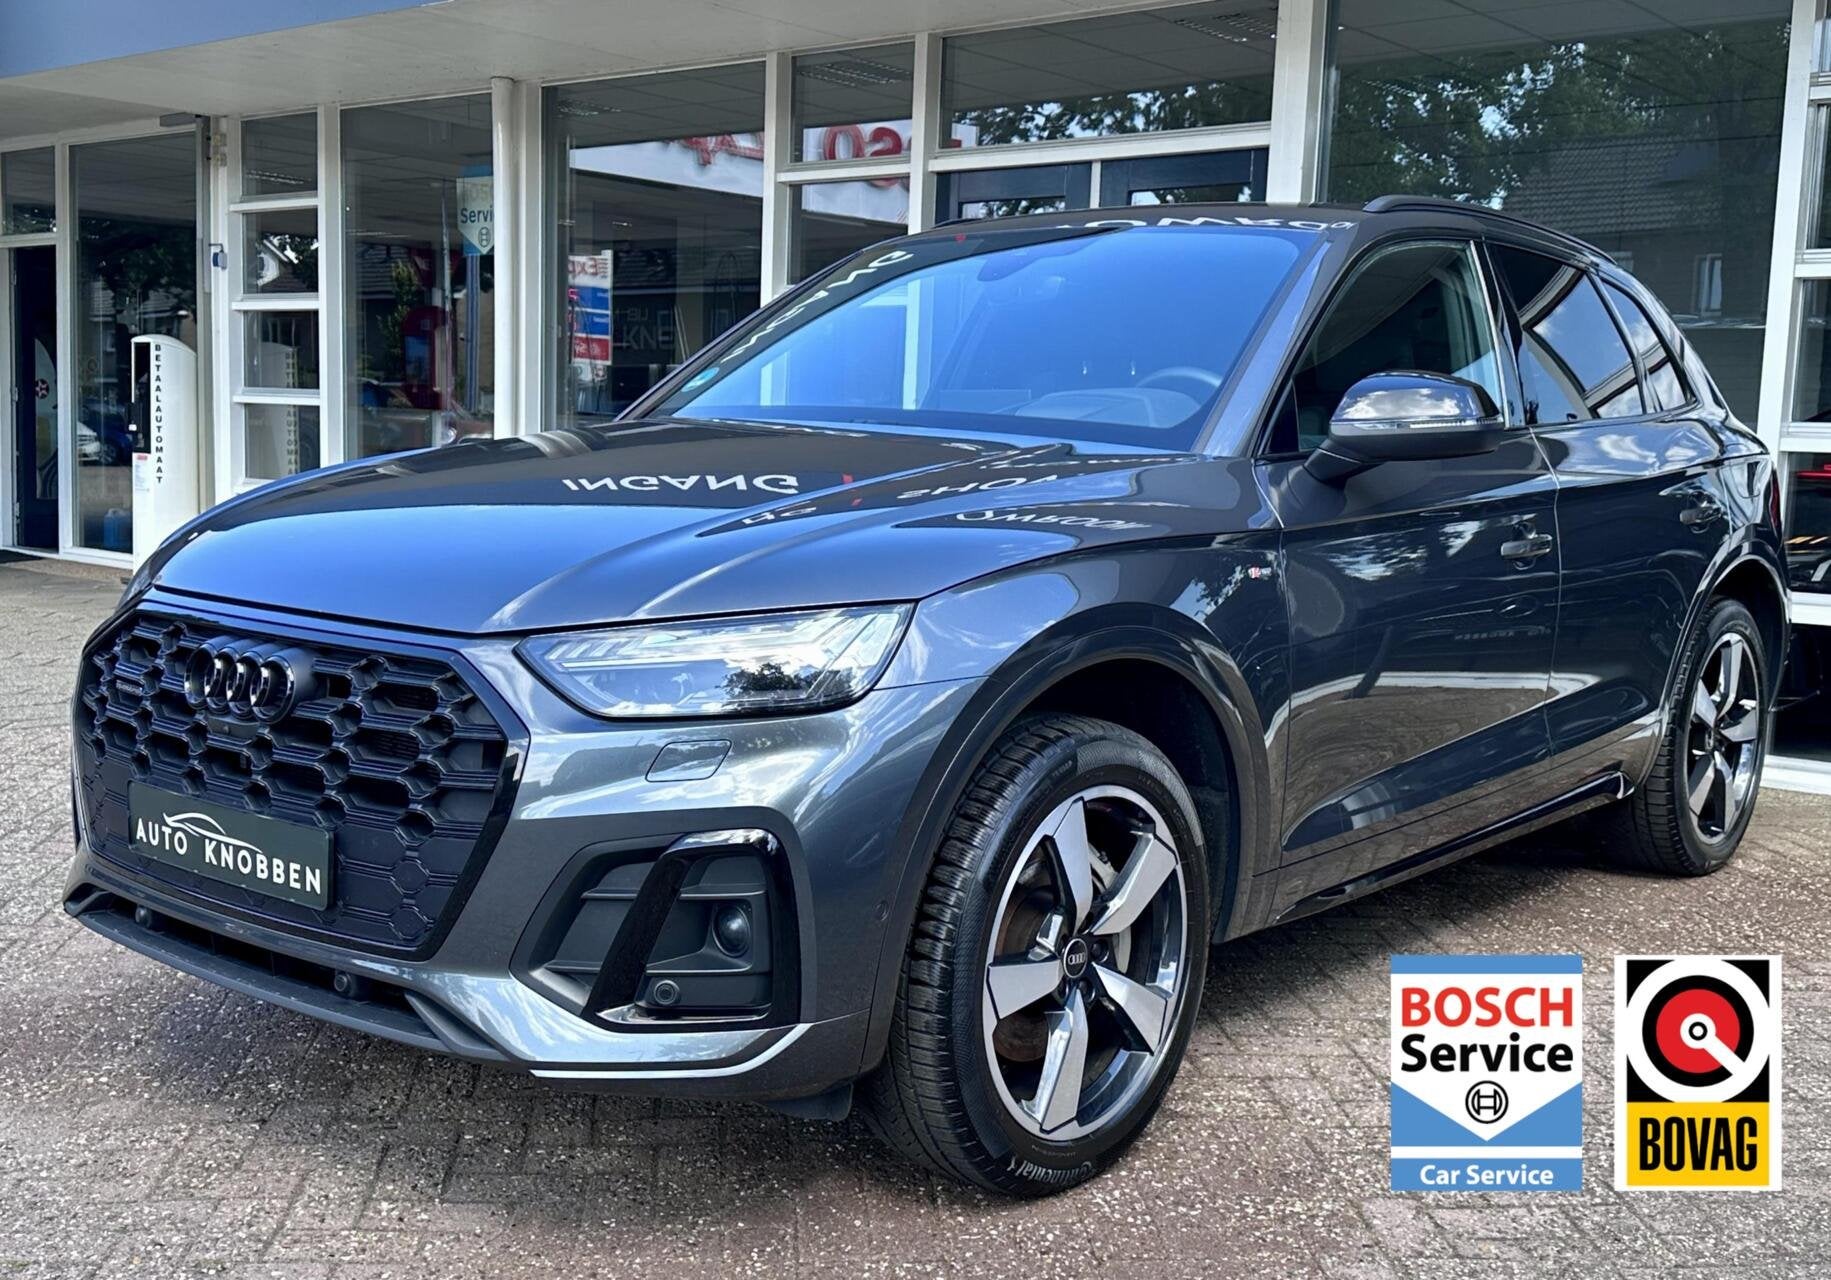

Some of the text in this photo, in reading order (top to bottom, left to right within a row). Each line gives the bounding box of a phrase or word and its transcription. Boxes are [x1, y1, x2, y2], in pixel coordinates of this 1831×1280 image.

[154, 343, 164, 484] BETAALAUTOMAAT
[136, 817, 321, 895] AUTO KNOBBEN
